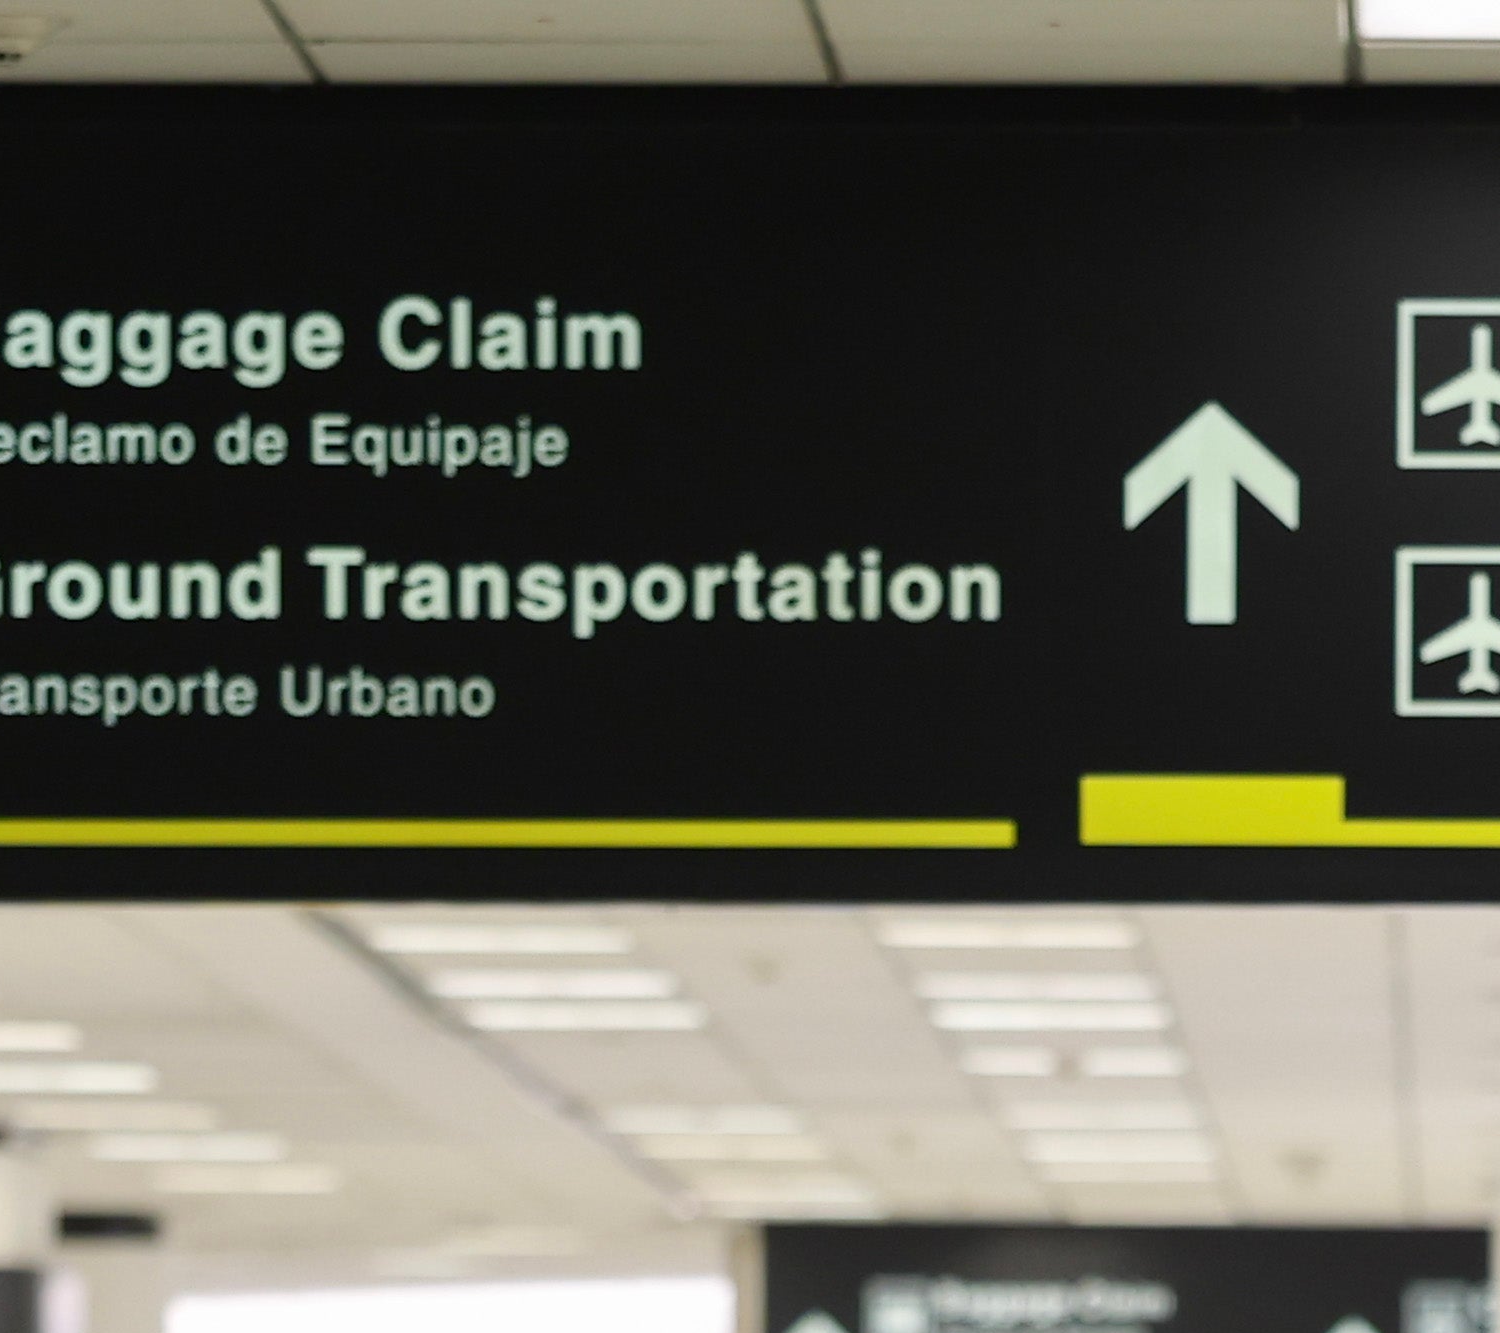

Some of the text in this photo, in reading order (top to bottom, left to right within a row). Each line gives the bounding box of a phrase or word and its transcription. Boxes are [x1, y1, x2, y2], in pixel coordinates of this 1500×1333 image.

[378, 294, 643, 372] Claim
[214, 413, 289, 466] de
[310, 413, 570, 478] Equipaje
[305, 545, 1003, 638] Transportation
[279, 666, 496, 719] Urbano
